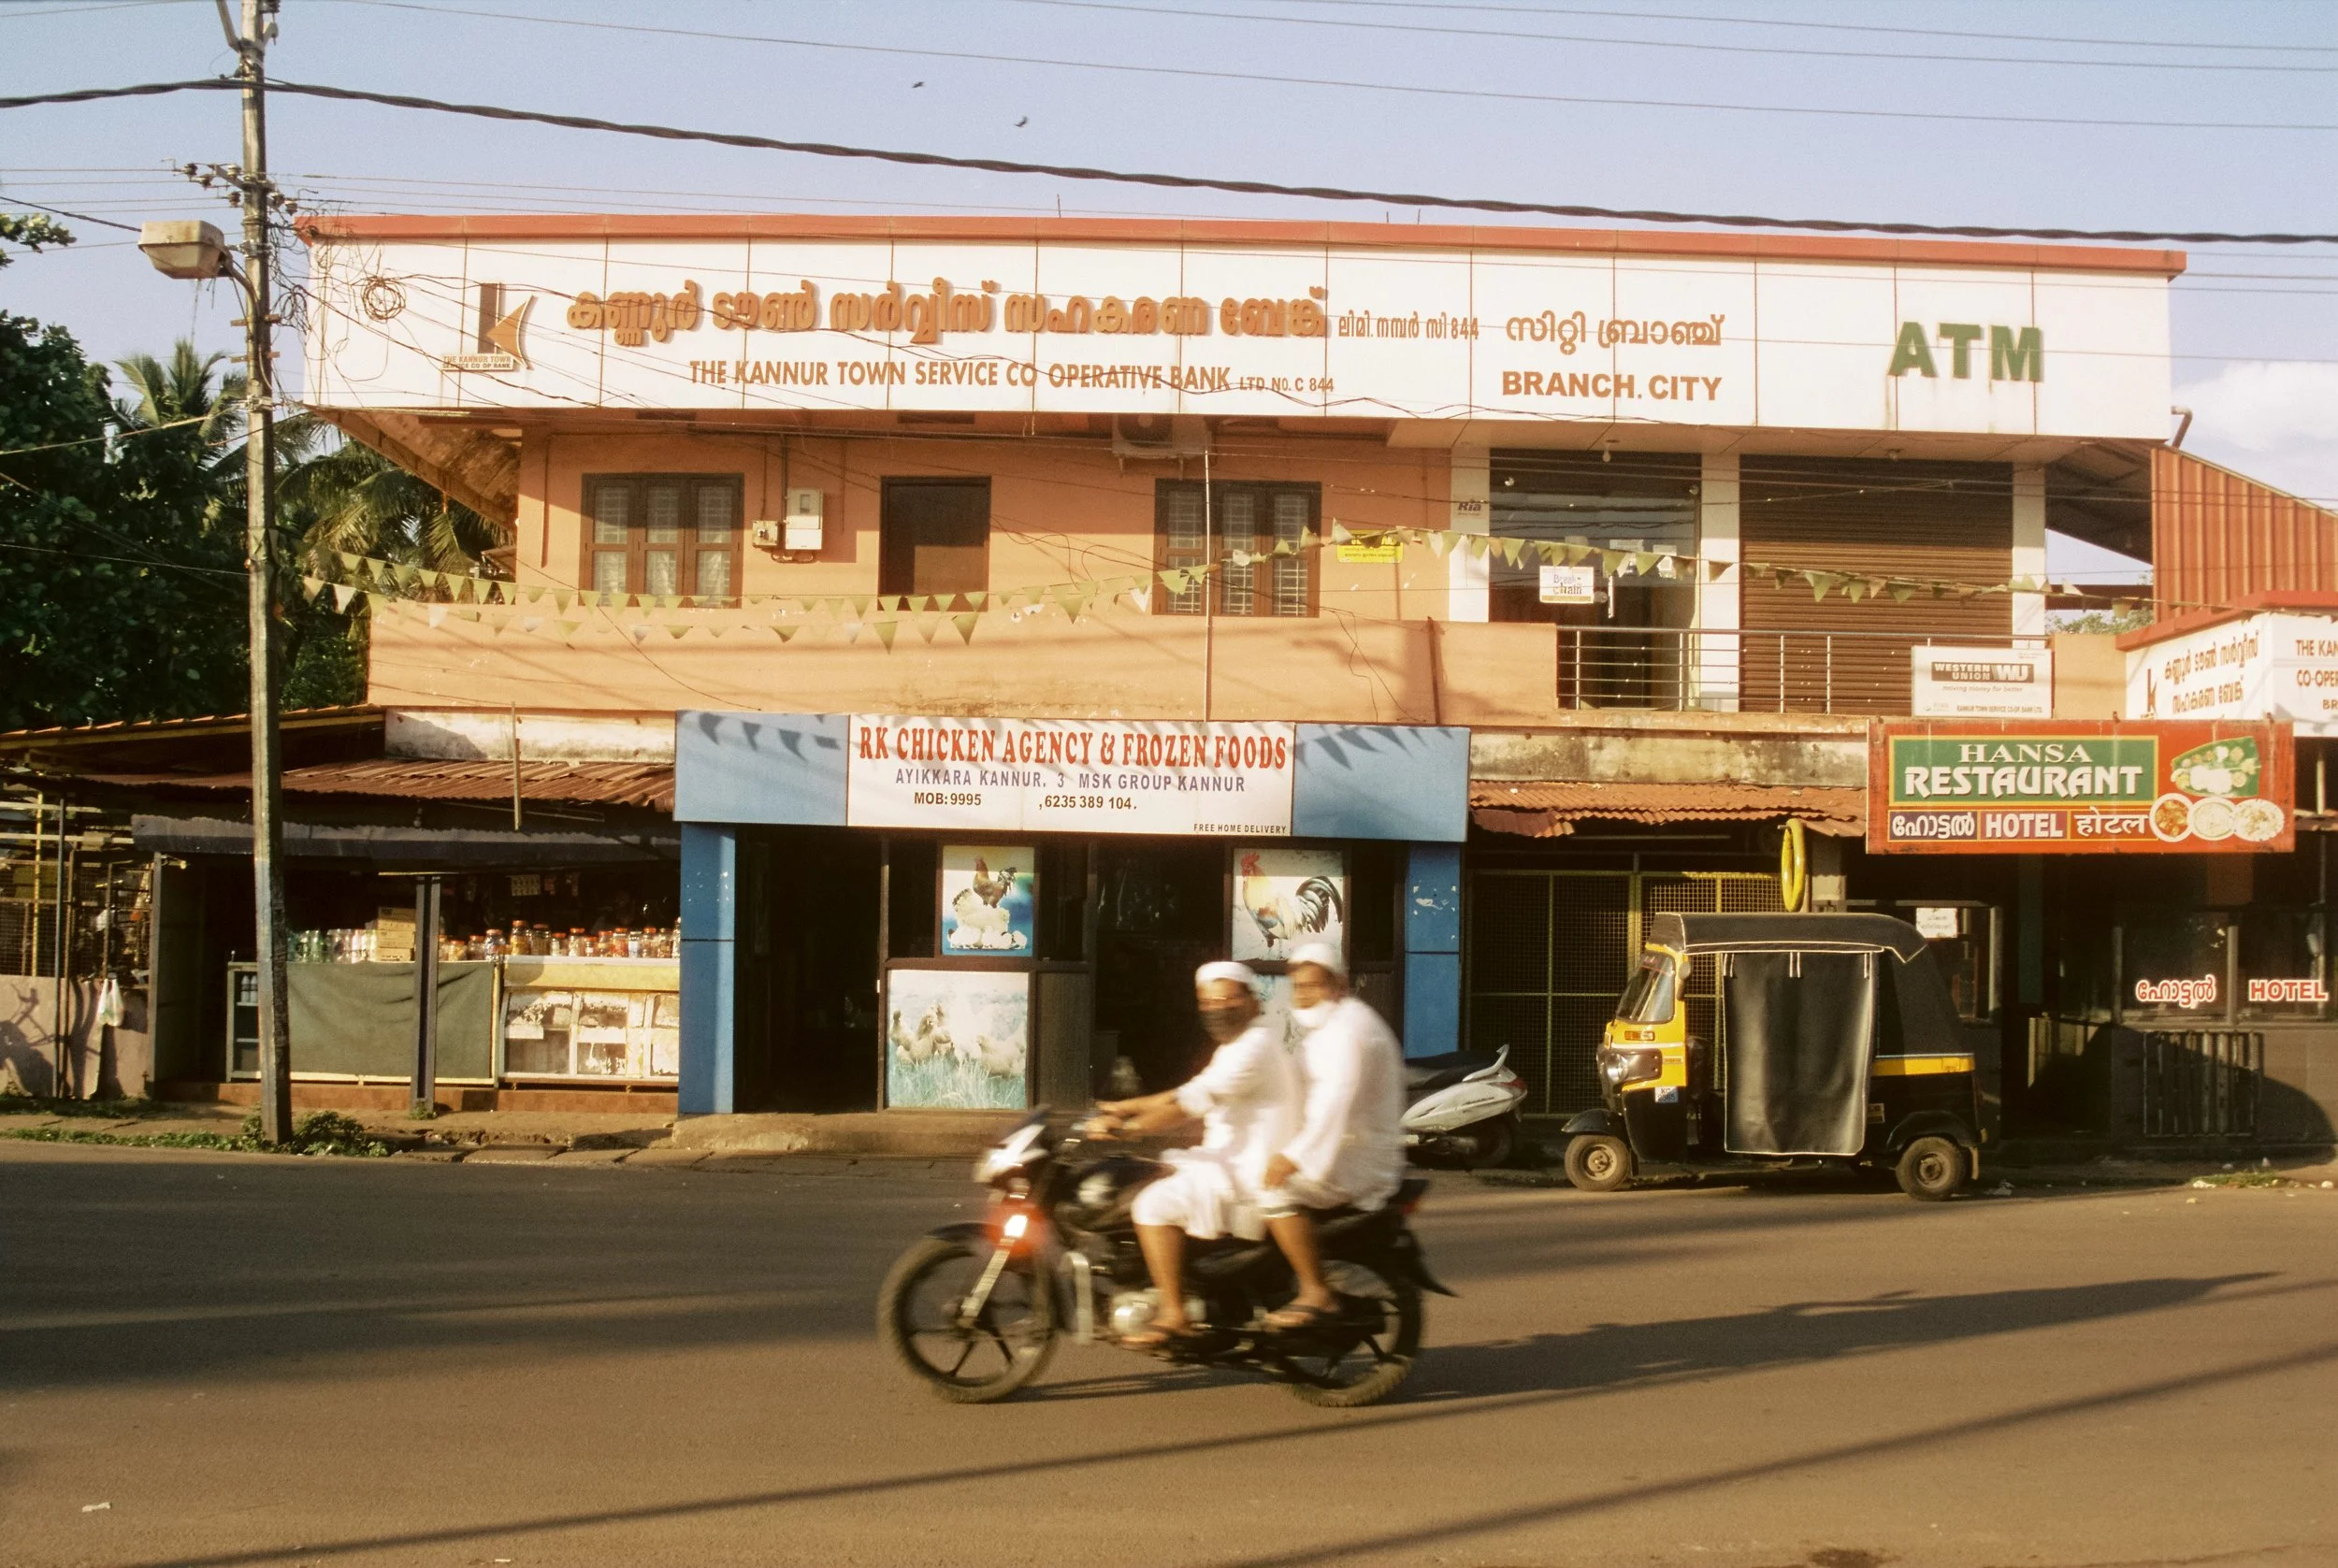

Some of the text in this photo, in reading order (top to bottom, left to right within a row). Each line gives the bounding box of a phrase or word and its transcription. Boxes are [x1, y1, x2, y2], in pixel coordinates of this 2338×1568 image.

[1004, 294, 1208, 336] സഹകരണ
[1450, 317, 1479, 339] 844
[1506, 309, 1587, 355] സിറ്റി
[1887, 321, 2044, 382] ATM
[689, 361, 728, 384] THE
[734, 361, 829, 386] KANNUR
[837, 361, 906, 386] TOWN
[915, 361, 999, 386] SERVICE
[1006, 362, 1038, 387] CO
[1048, 363, 1162, 389] OPERATIVE
[1170, 365, 1232, 391] BANK
[1294, 378, 1304, 392] C
[1309, 378, 1335, 393] 844
[1649, 375, 1723, 401] CITY
[2296, 640, 2315, 655] THE
[1934, 663, 1991, 672] WESTERN
[1952, 672, 1991, 681] UNION
[859, 726, 1286, 770] RK CHICKEN AGENCY & FROZEN FOODS
[1959, 743, 2093, 763] HANSA
[896, 769, 972, 785] AYIKKARA
[1058, 772, 1065, 788] 3
[1078, 773, 1112, 789] MSK
[1118, 774, 1172, 790] GROUP
[1177, 775, 1245, 792] KANNUR
[1904, 766, 2143, 798] RESTAURANT
[1079, 796, 1104, 809] 389
[1193, 824, 1287, 834] FREE HOME DELIVERY
[1892, 812, 1975, 840] ഹോട്ടൽ
[1985, 813, 2063, 838] HOTEL
[2073, 806, 2150, 837] होटल
[2136, 974, 2216, 1007] ഹോട്ടൽ
[2249, 980, 2329, 1001] HOTEL
